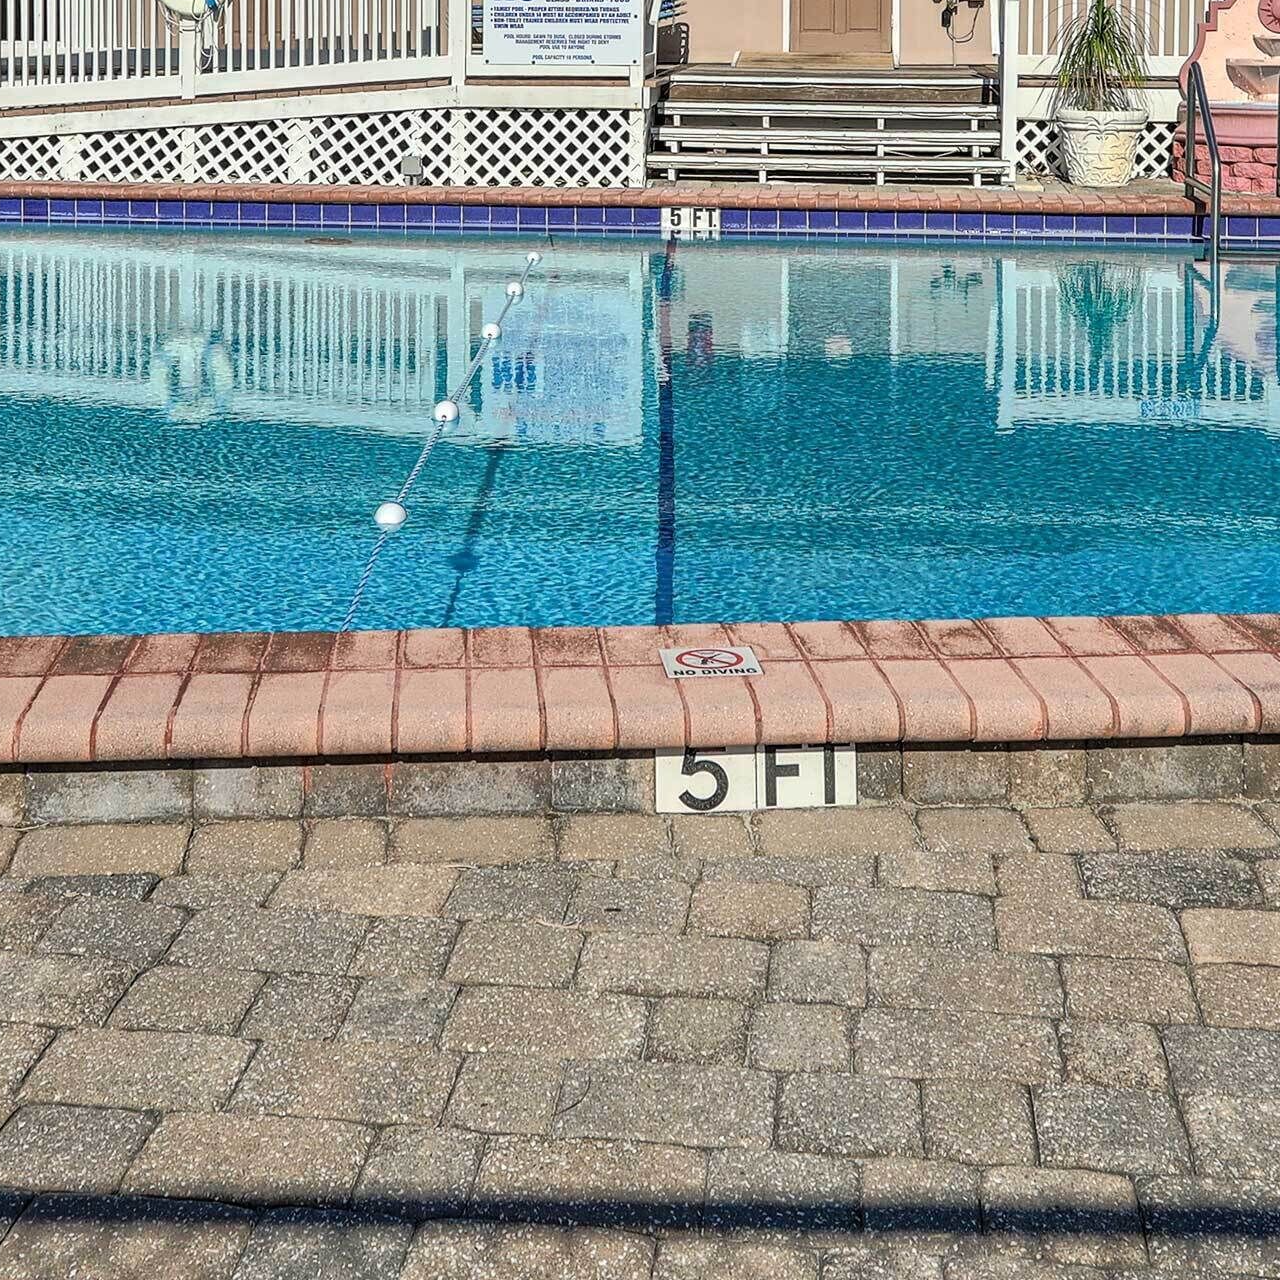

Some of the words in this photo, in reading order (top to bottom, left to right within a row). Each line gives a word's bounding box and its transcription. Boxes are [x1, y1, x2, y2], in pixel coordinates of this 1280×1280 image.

[670, 207, 681, 226] 5
[693, 208, 717, 228] FT.
[701, 667, 758, 676] DIVING
[678, 745, 729, 811] 5
[765, 743, 851, 807] FT
